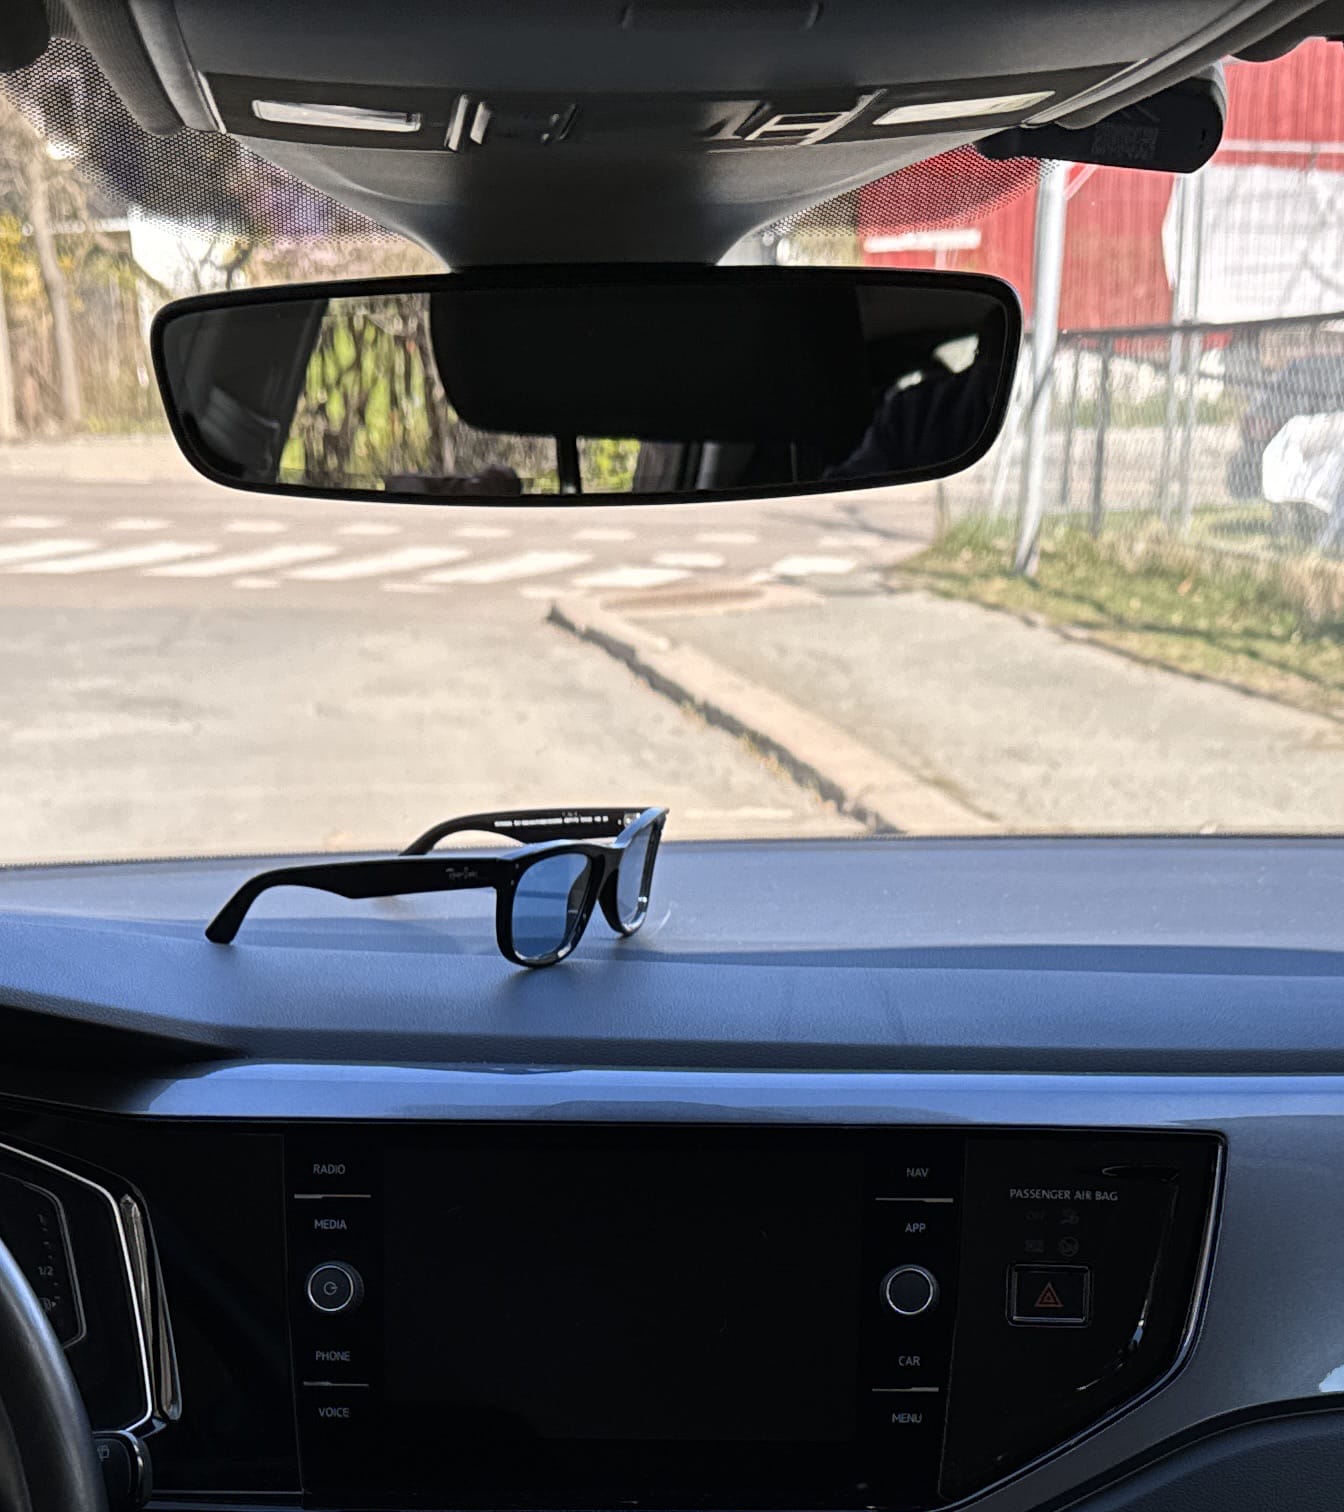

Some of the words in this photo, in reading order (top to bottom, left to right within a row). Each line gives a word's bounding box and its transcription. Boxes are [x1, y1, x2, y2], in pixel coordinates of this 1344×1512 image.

[312, 1163, 347, 1175] RADIO
[906, 1167, 929, 1178] NAV
[1009, 1188, 1071, 1201] PASSENGER
[1073, 1189, 1092, 1201] AIR
[1094, 1190, 1119, 1202] BAG
[313, 1218, 349, 1230] MEDIA
[904, 1222, 927, 1233] APP
[314, 1350, 351, 1362] PHONE
[897, 1355, 921, 1367] CAR
[318, 1406, 351, 1418] VOICE
[891, 1412, 923, 1424] MENU
